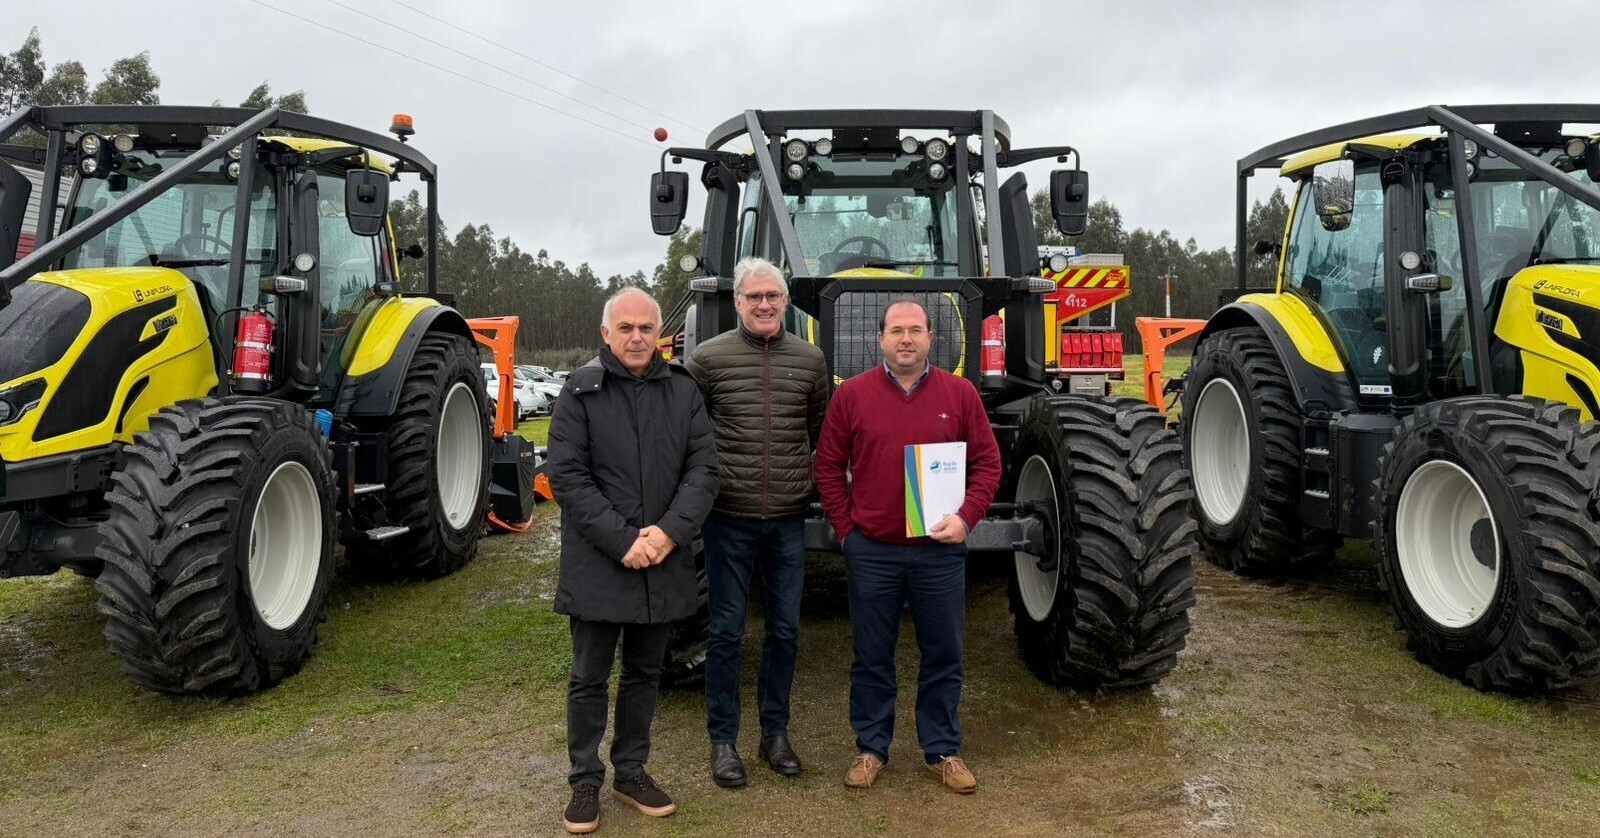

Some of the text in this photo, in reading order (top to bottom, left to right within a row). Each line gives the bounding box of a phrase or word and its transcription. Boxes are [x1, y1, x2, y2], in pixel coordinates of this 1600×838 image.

[143, 285, 173, 297] UNIFLORA
[1544, 284, 1580, 297] UNIFLORA
[1069, 298, 1087, 308] 112
